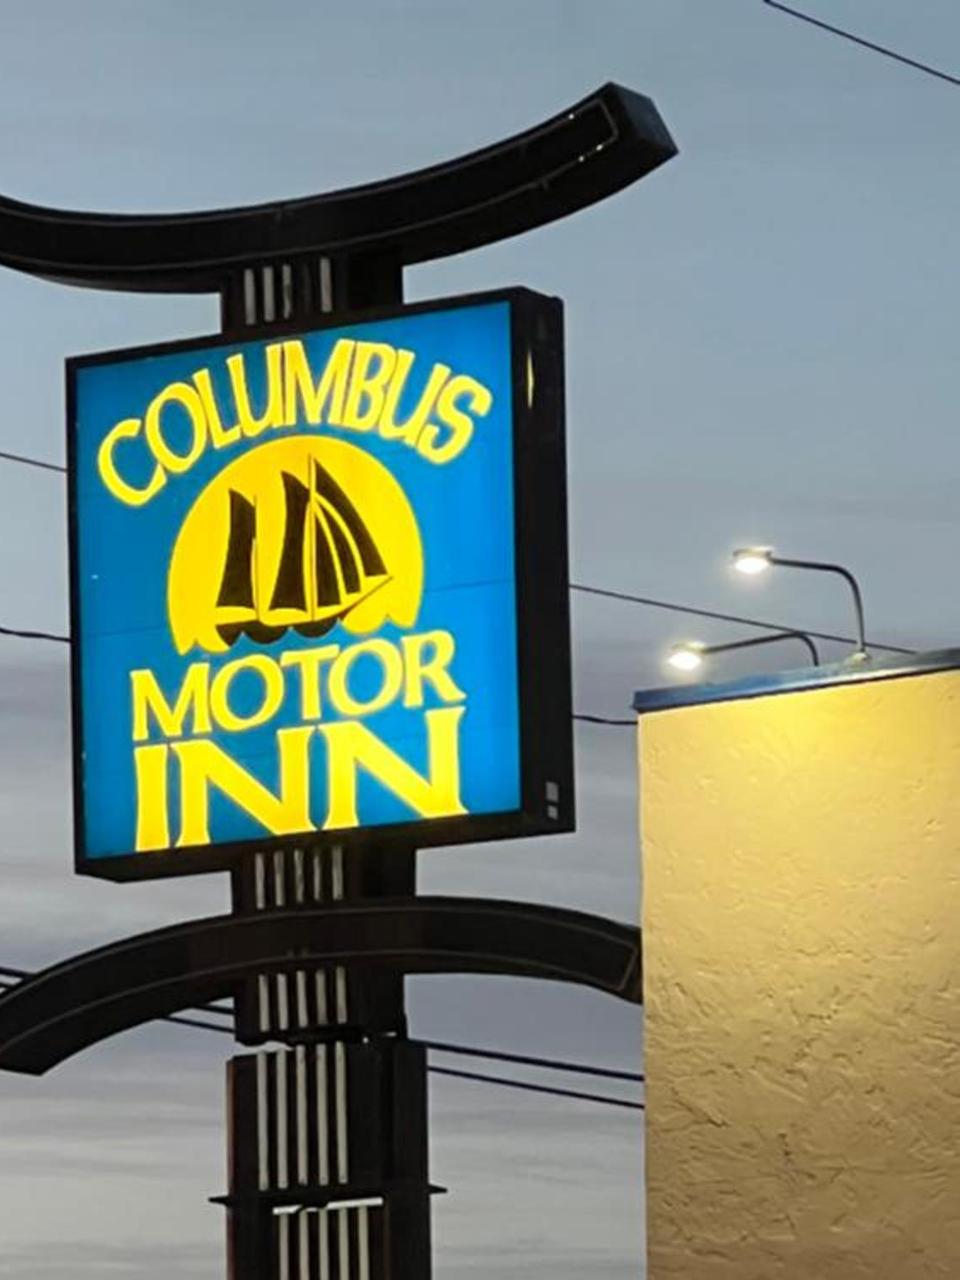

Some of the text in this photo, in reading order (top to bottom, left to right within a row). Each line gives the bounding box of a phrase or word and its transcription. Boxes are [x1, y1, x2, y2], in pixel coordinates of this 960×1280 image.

[97, 338, 493, 507] COLUMBUS
[129, 629, 468, 743] MOTOR
[133, 705, 470, 852] INN
